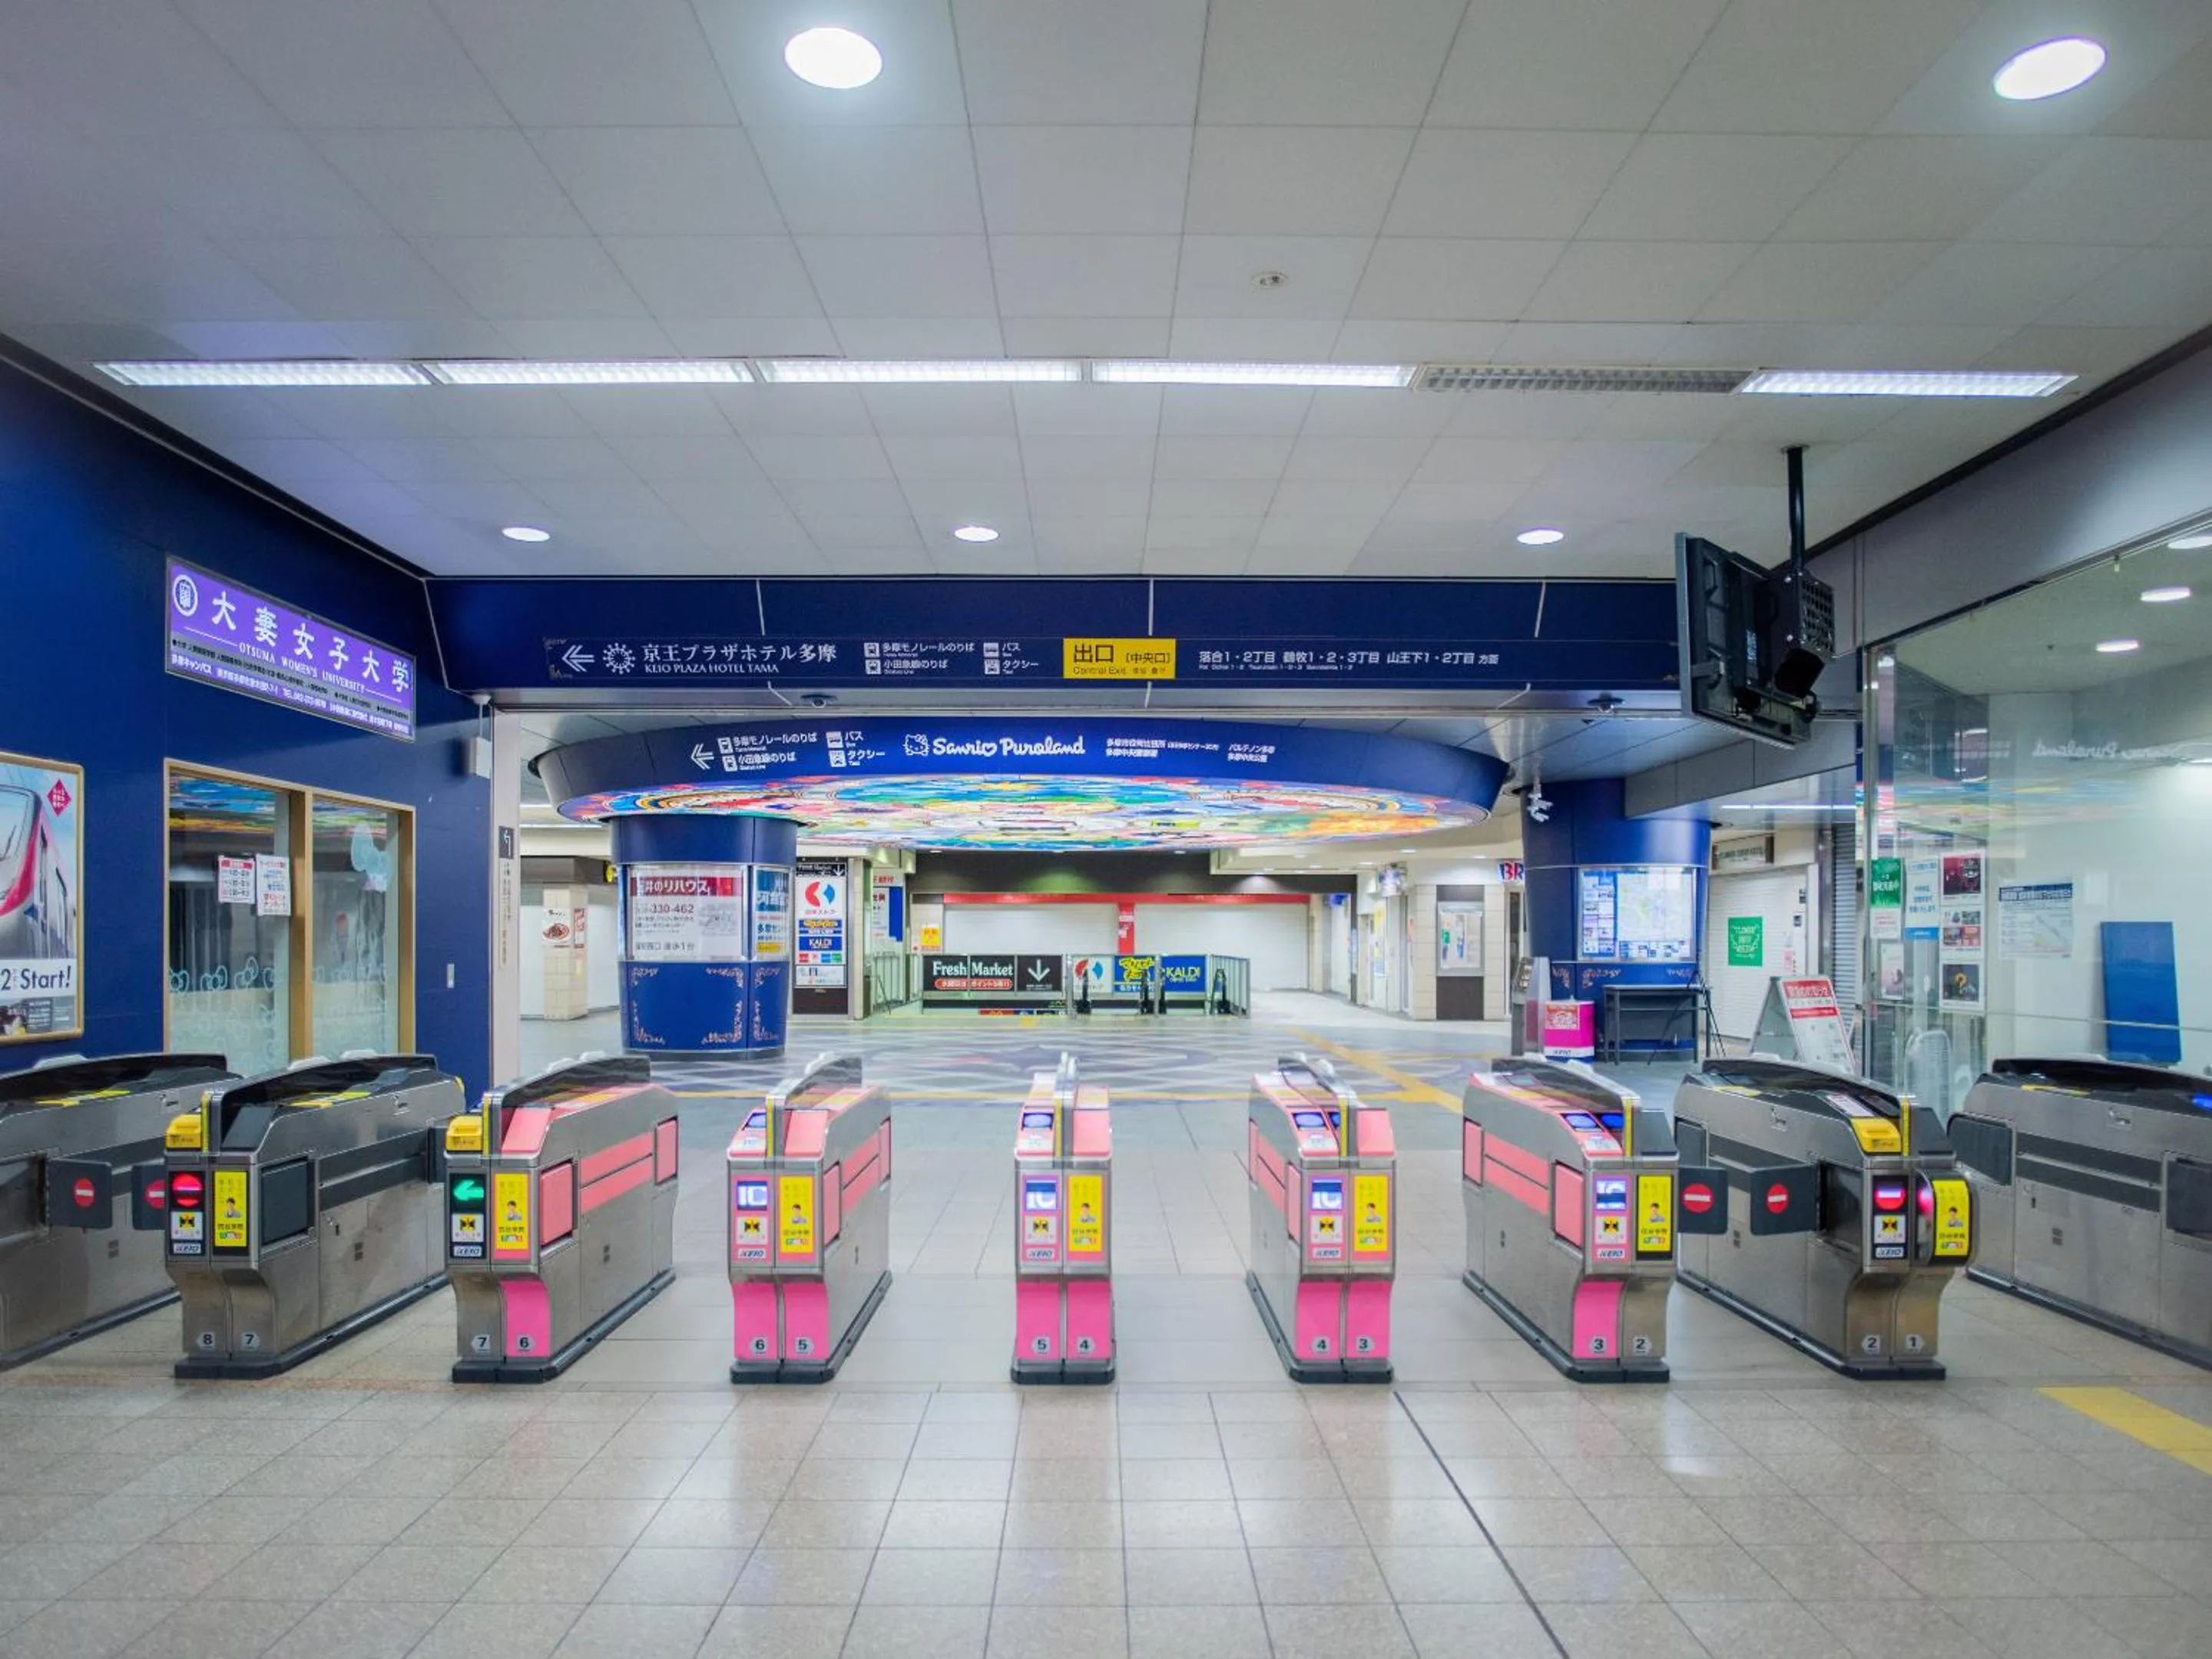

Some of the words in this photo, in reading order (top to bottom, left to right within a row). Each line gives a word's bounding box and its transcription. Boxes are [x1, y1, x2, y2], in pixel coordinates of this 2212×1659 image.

[211, 590, 410, 693] 大妻女子大学
[882, 642, 975, 653] 多摩モノレールのりば
[1002, 642, 1021, 651] バス
[642, 643, 838, 664] 京王プラザホテル多摩
[1073, 643, 1114, 664] 出口
[238, 642, 276, 664] OTSUMA
[281, 655, 318, 677] WOMEN'S
[322, 670, 366, 694] UNIVERSITY
[674, 664, 707, 674] PLAZA
[709, 664, 744, 674] HOTEL
[747, 664, 780, 674] TAMA
[1002, 660, 1039, 669] タクシー
[844, 731, 864, 741] バス
[932, 737, 998, 757] Sanrio
[998, 734, 1086, 757] Puroland
[847, 751, 886, 760] タクシー
[932, 960, 968, 976] Fresh
[972, 961, 1014, 977] Market
[1166, 966, 1201, 979] KALDI
[20, 965, 72, 991] Start!
[738, 1185, 767, 1207] IC
[203, 1333, 213, 1345] 8
[245, 1333, 255, 1345] 7
[478, 1336, 488, 1348] 7
[519, 1336, 529, 1349] 6
[755, 1339, 765, 1350] 6
[798, 1339, 807, 1350] 5
[1037, 1339, 1047, 1350] 5
[1079, 1339, 1090, 1350] 4
[1316, 1339, 1327, 1350] 4
[1359, 1338, 1369, 1349] 3
[1594, 1338, 1604, 1349] 3
[1635, 1337, 1646, 1349] 2
[1867, 1336, 1878, 1348] 2
[1909, 1336, 1917, 1347] 1
